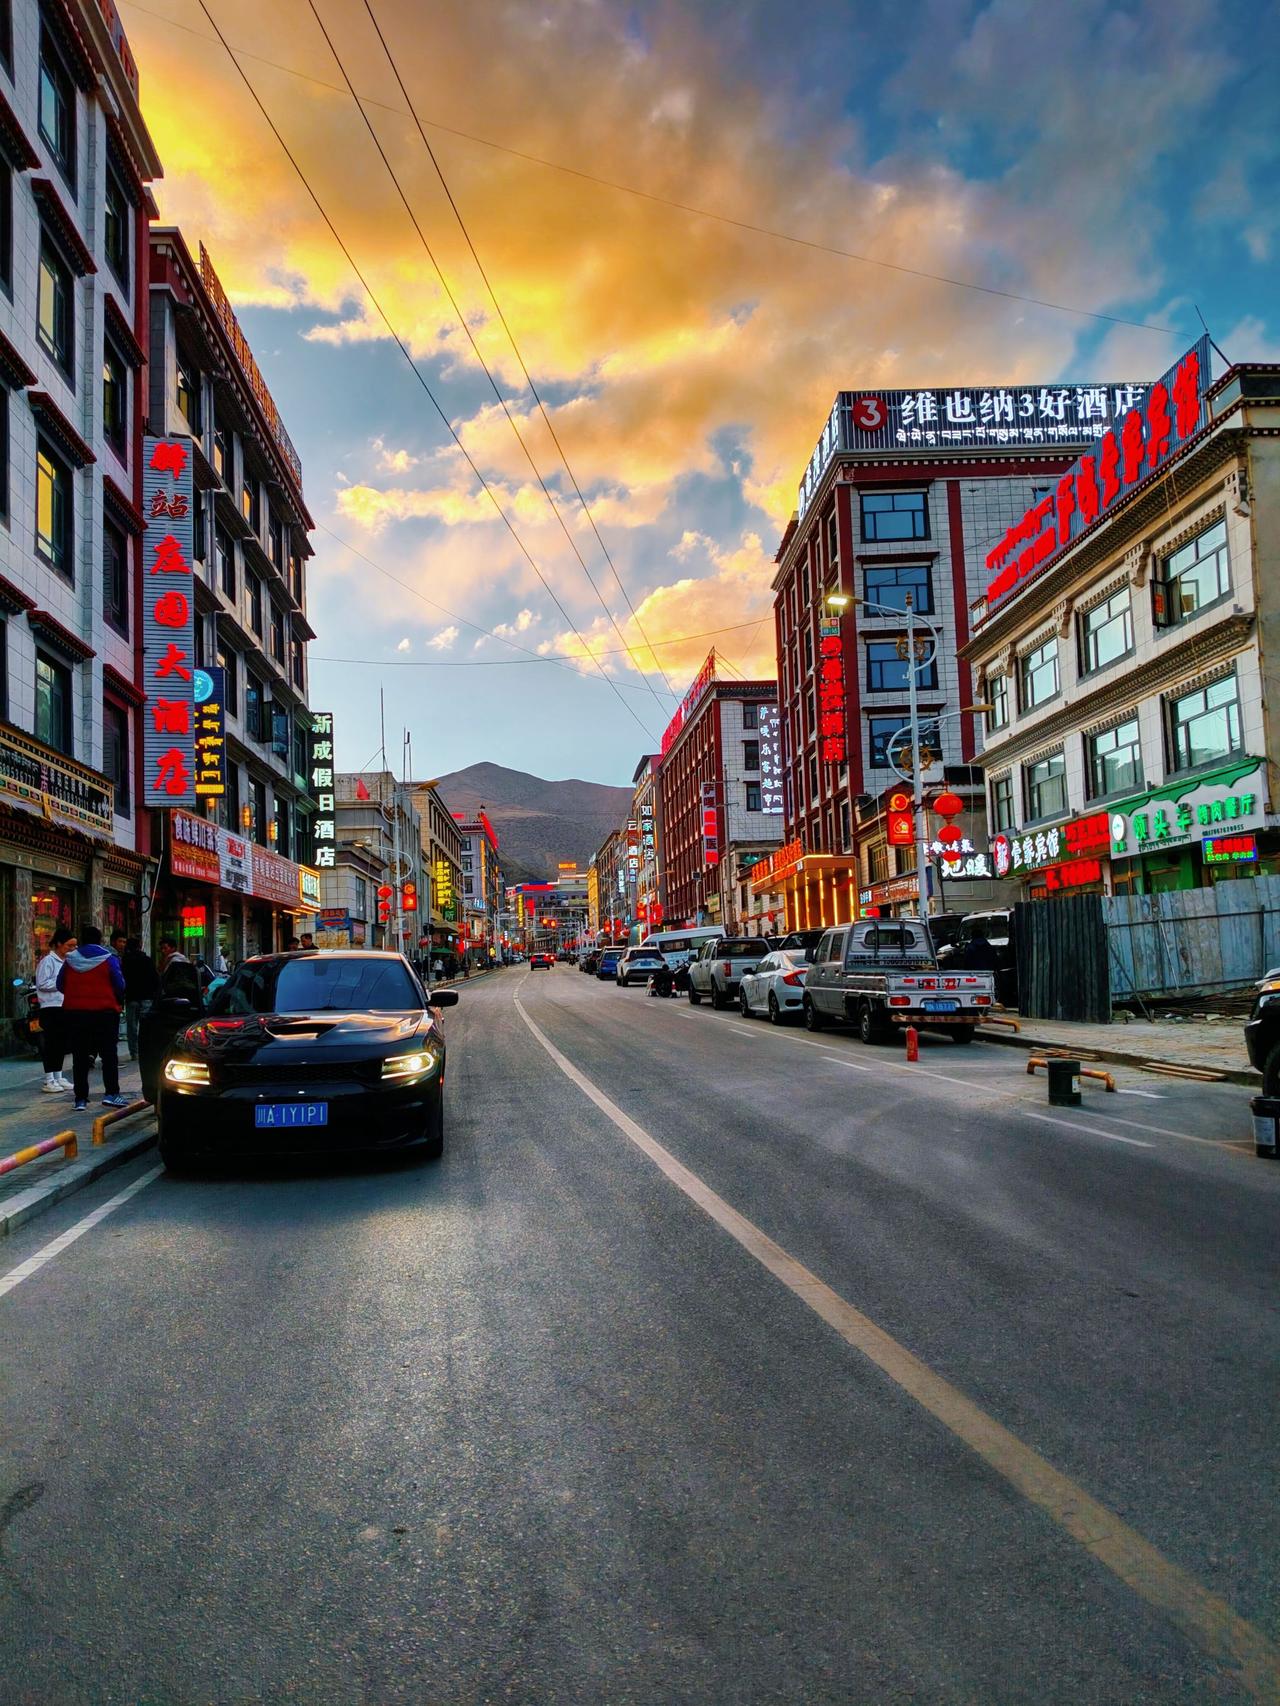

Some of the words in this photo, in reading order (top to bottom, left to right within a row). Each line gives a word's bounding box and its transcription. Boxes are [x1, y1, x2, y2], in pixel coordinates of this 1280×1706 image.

[859, 400, 884, 427] 3
[312, 714, 335, 866] 新成假日酒店
